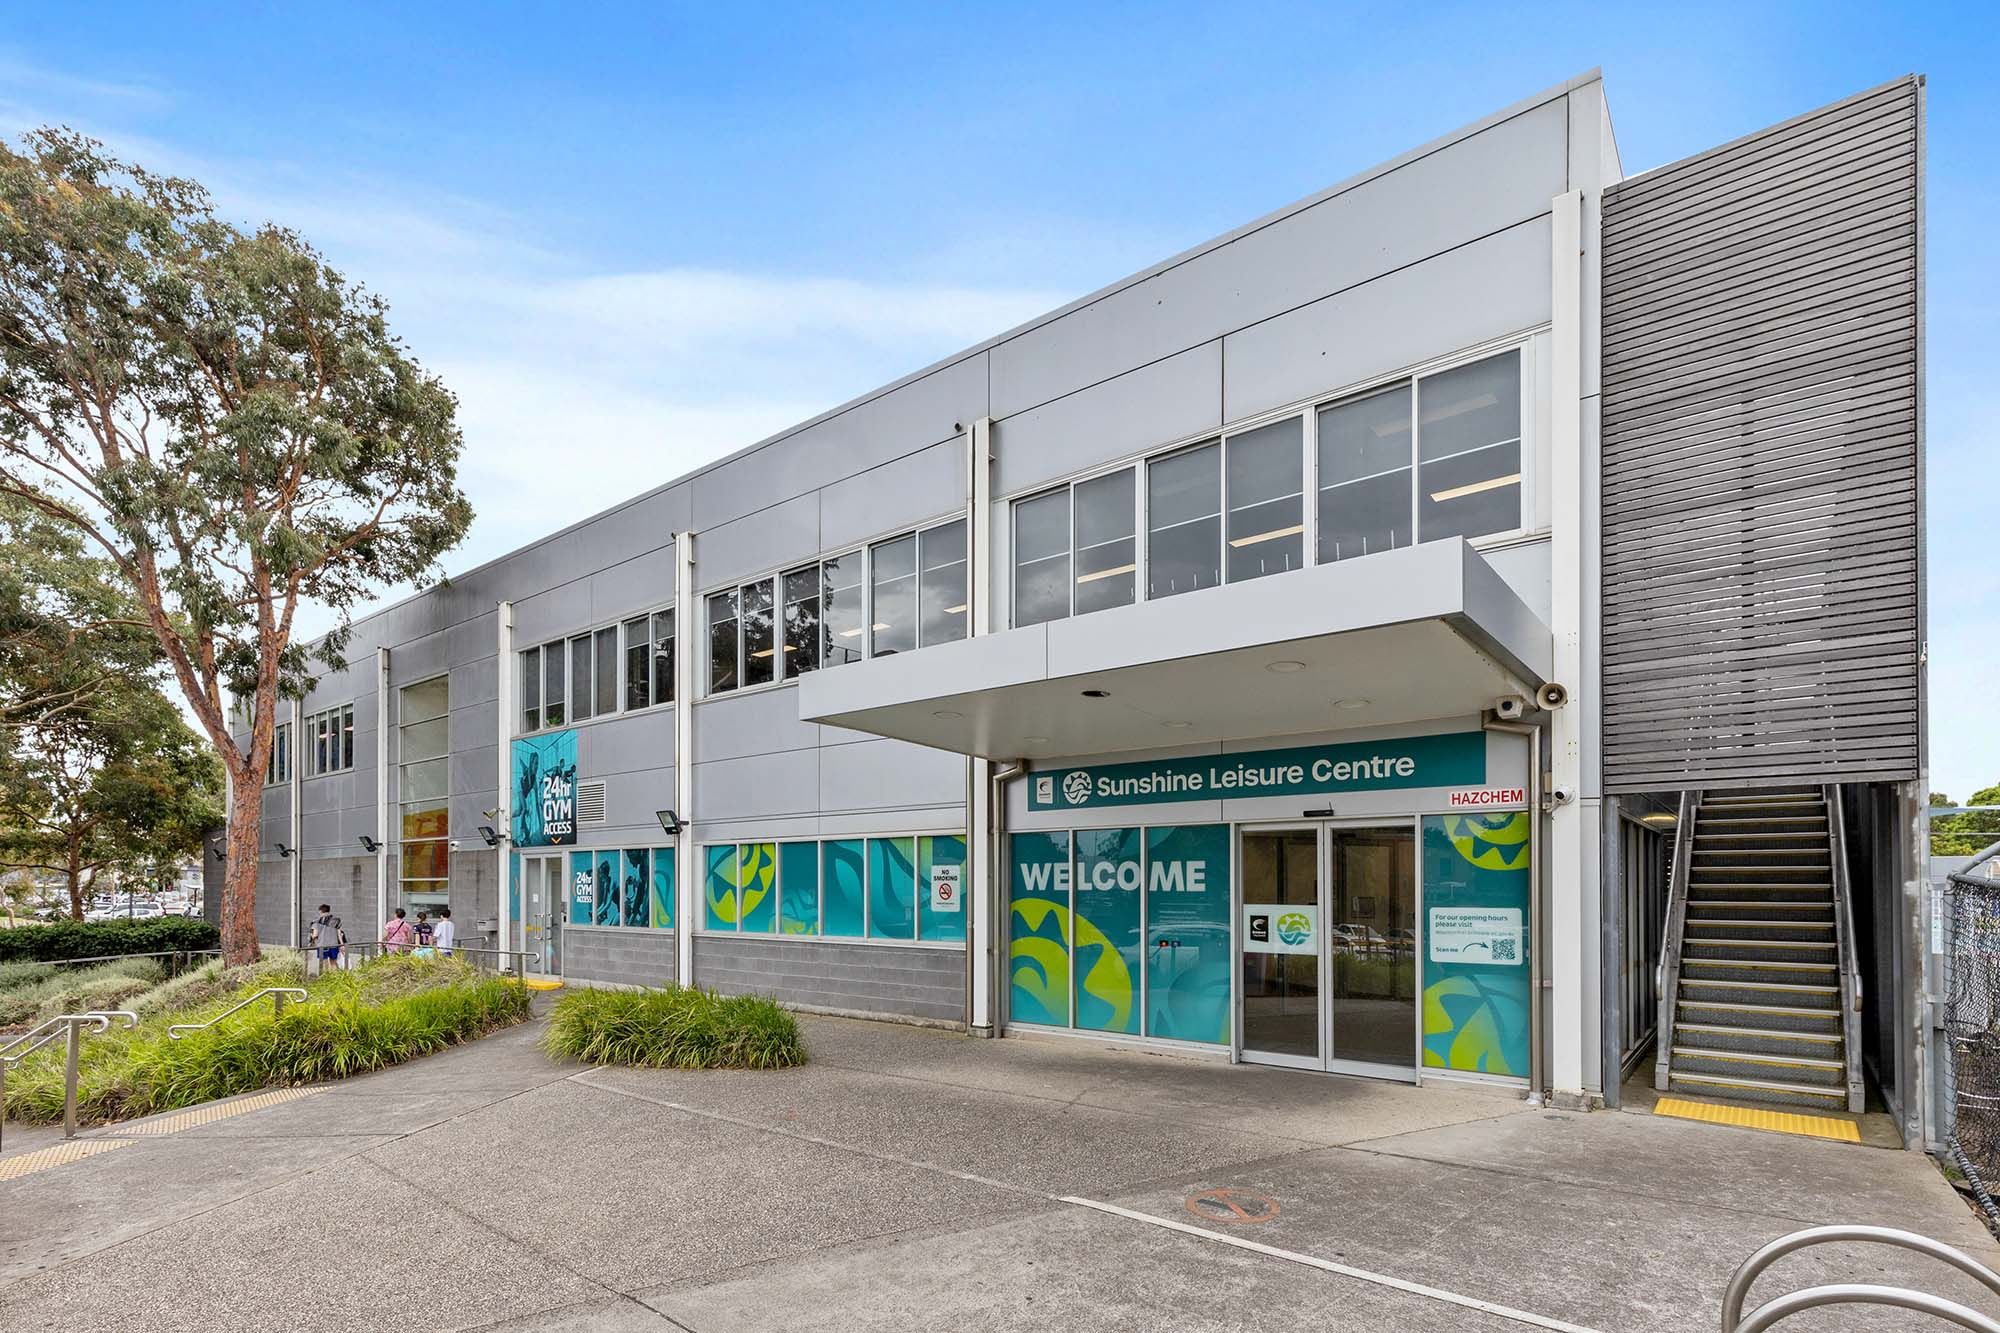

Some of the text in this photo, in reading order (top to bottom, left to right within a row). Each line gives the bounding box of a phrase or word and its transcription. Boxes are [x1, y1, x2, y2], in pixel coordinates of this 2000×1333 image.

[1097, 755, 1415, 797] Sunshine Leisure Centre
[543, 776, 571, 799] 24hr
[1451, 790, 1523, 806] HAZCHEM
[543, 799, 572, 820] GYM
[543, 821, 572, 835] ACCESS
[576, 872, 592, 884] 24hr
[1020, 861, 1206, 891] WELCOME
[576, 884, 592, 895] GYM
[1435, 920, 1457, 928] please
[1459, 914, 1487, 922] opening
